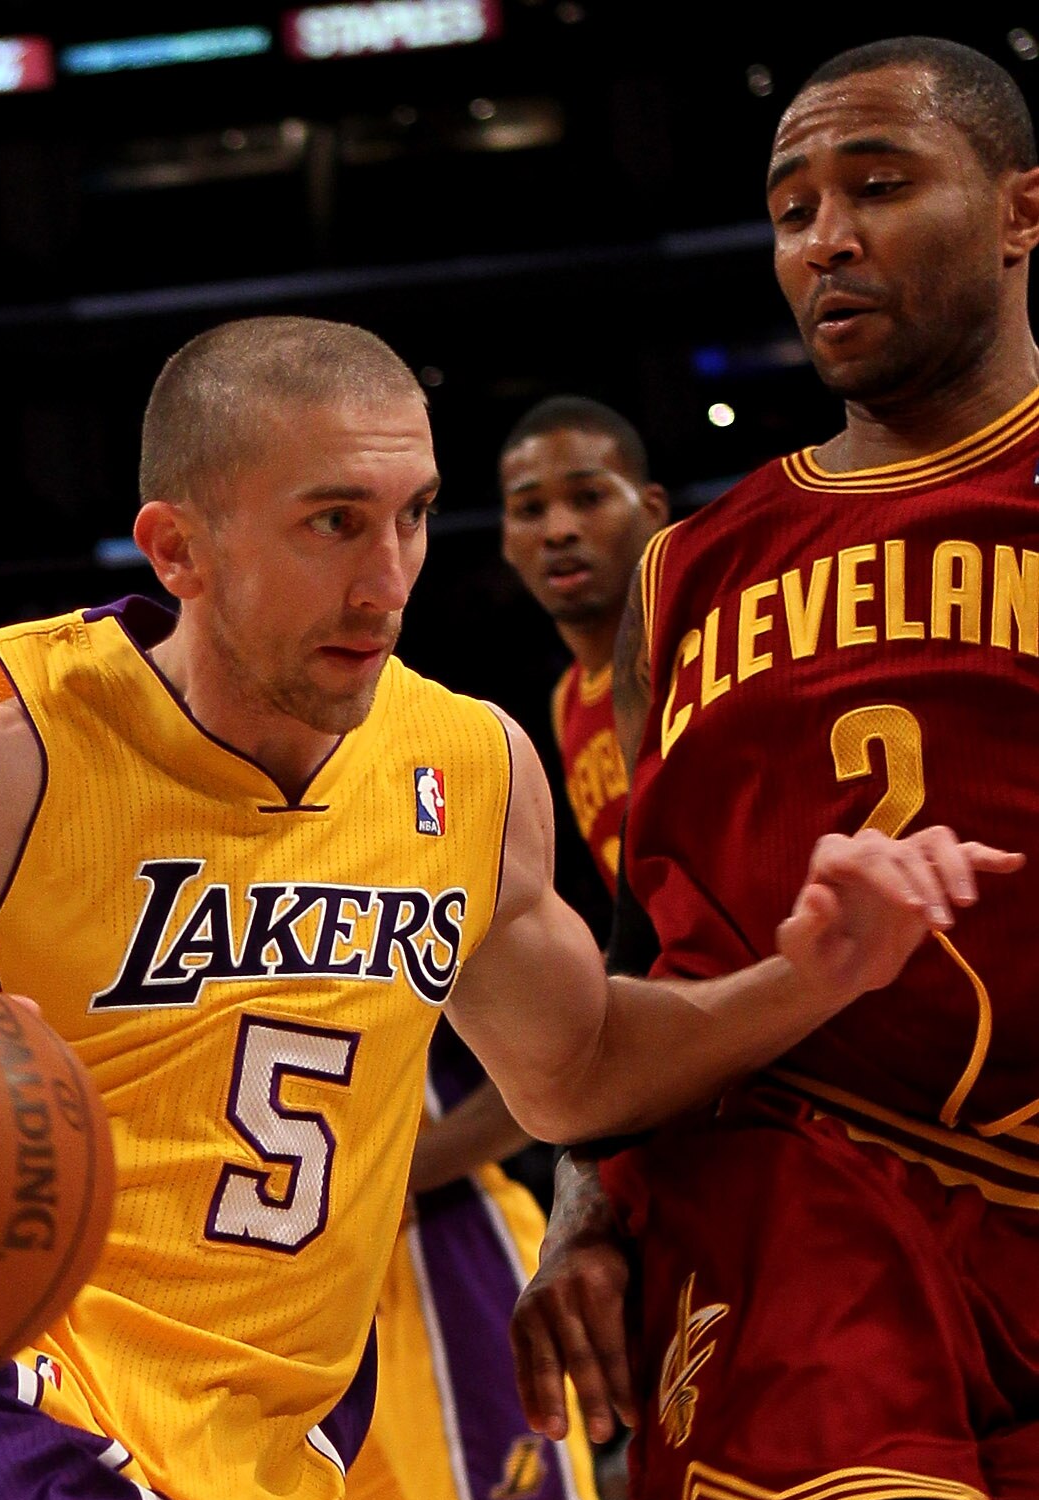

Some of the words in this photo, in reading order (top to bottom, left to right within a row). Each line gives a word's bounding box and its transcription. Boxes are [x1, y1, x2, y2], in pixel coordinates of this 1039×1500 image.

[660, 539, 1039, 761] CLEVELAN
[418, 819, 438, 833] NBA
[830, 704, 926, 840] 2
[87, 858, 467, 1013] LAKERS
[204, 1013, 362, 1256] 5
